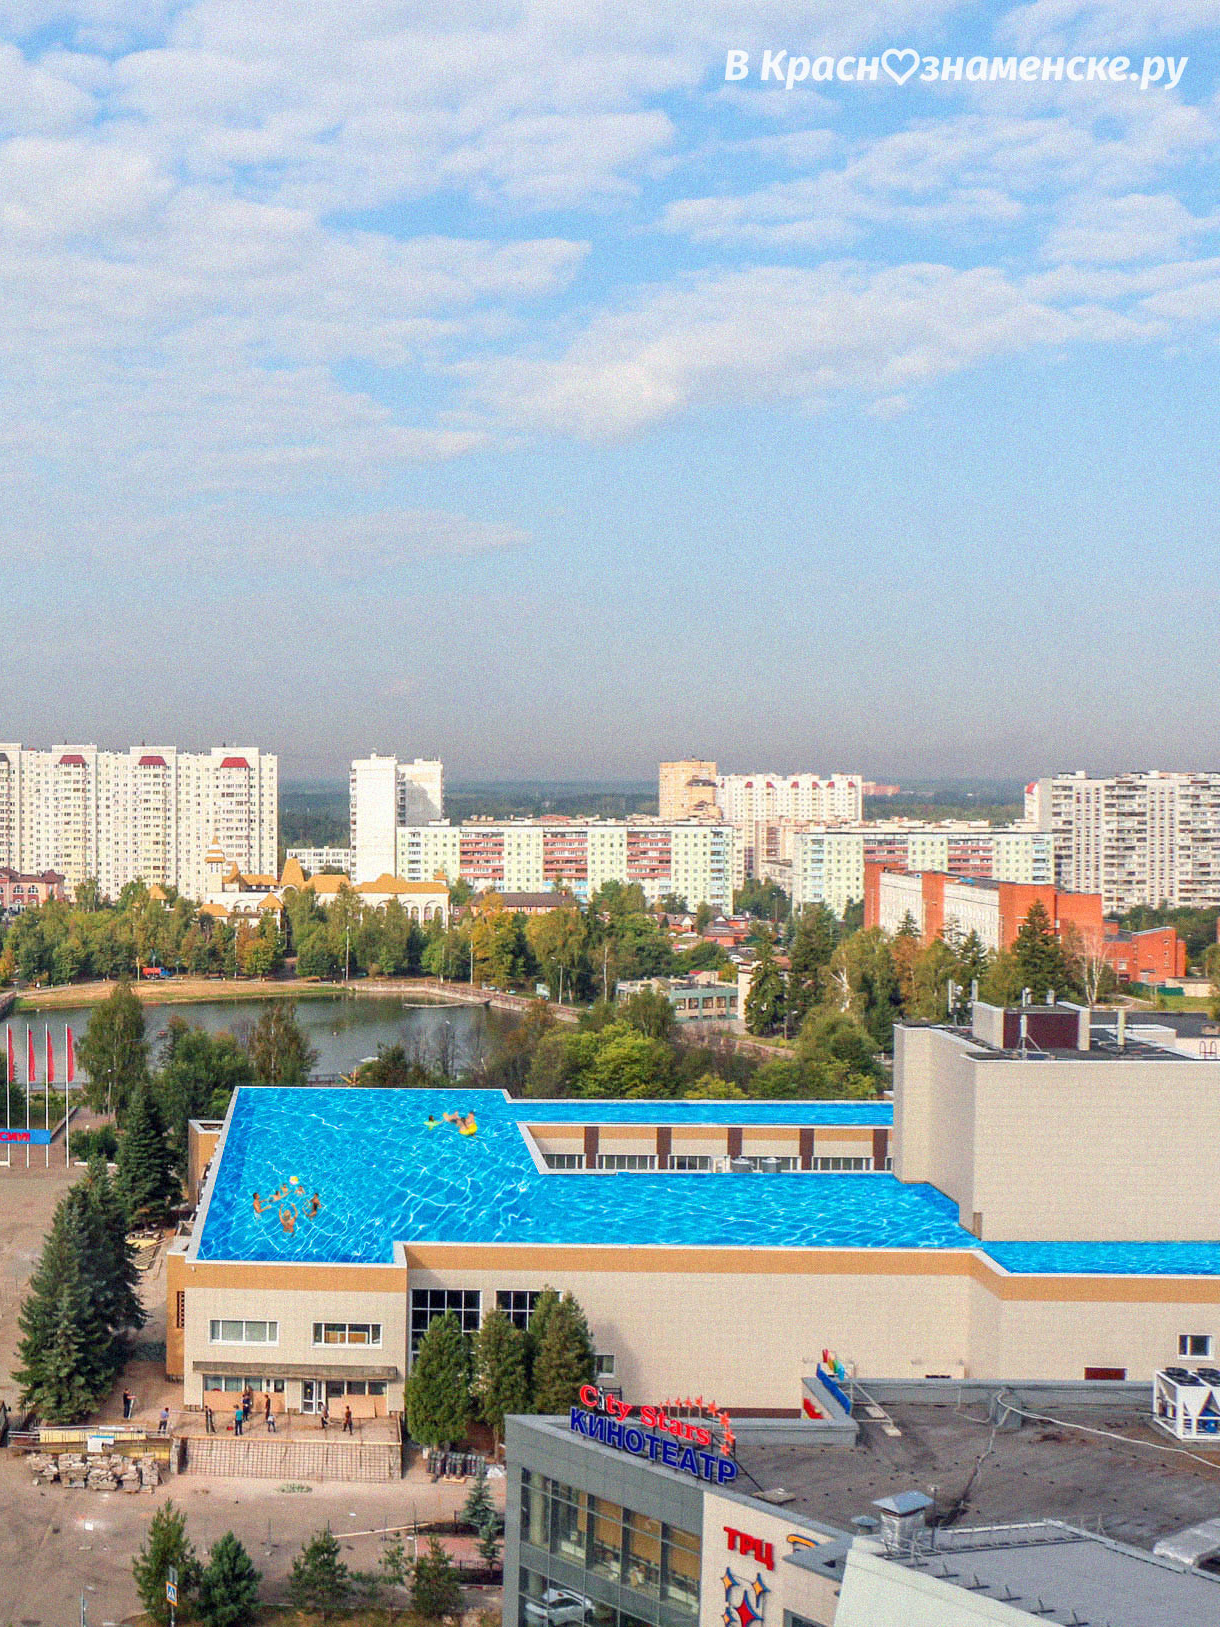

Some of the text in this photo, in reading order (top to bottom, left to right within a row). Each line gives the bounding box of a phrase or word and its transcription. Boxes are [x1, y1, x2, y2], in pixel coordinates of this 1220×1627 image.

[570, 1406, 738, 1486] КИНОТЕАТР
[580, 1384, 711, 1446] City Stars
[723, 1526, 775, 1572] ТРЦ
